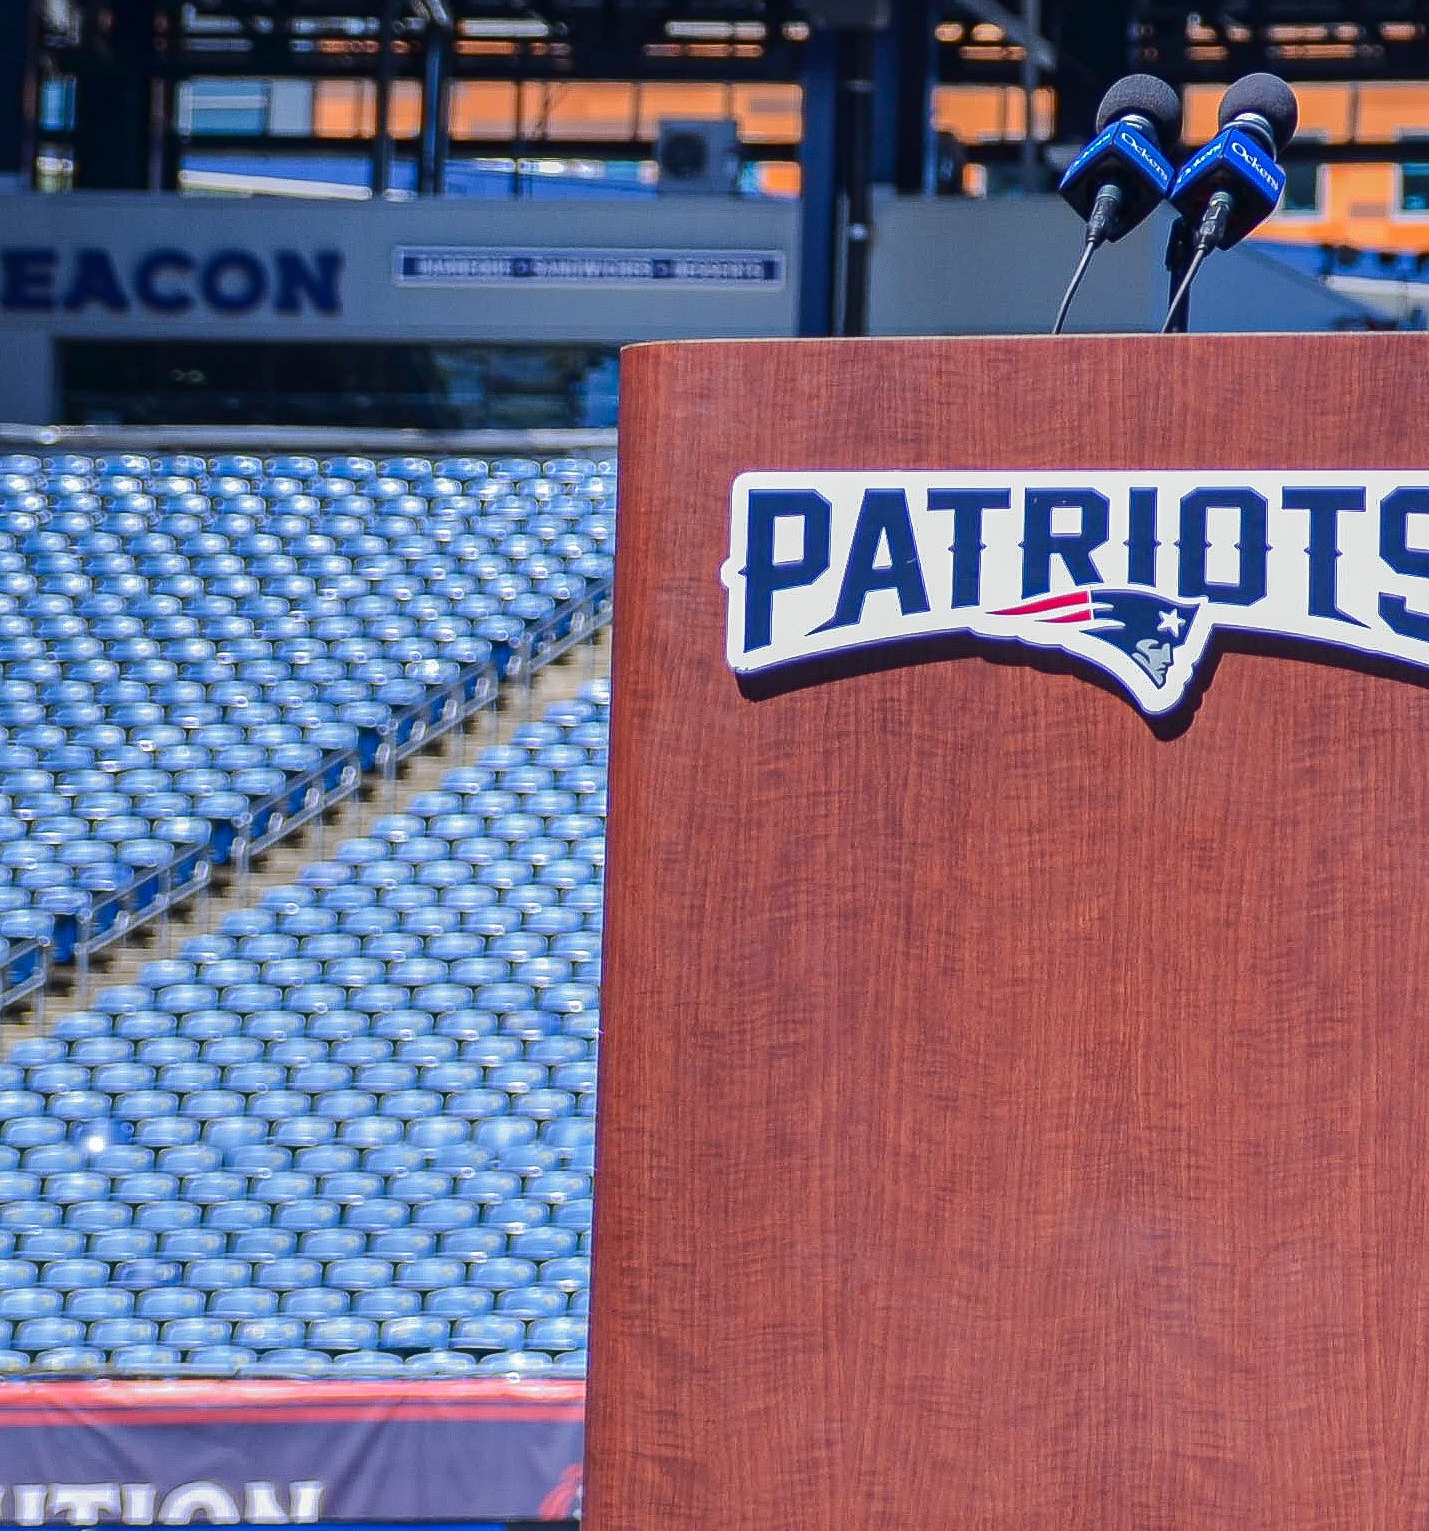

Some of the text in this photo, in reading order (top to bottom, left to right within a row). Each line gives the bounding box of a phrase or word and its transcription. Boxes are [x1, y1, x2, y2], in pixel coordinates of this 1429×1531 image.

[1229, 140, 1281, 193] Ockers
[0, 247, 346, 315] EACON
[0, 1480, 324, 1527] ITION
